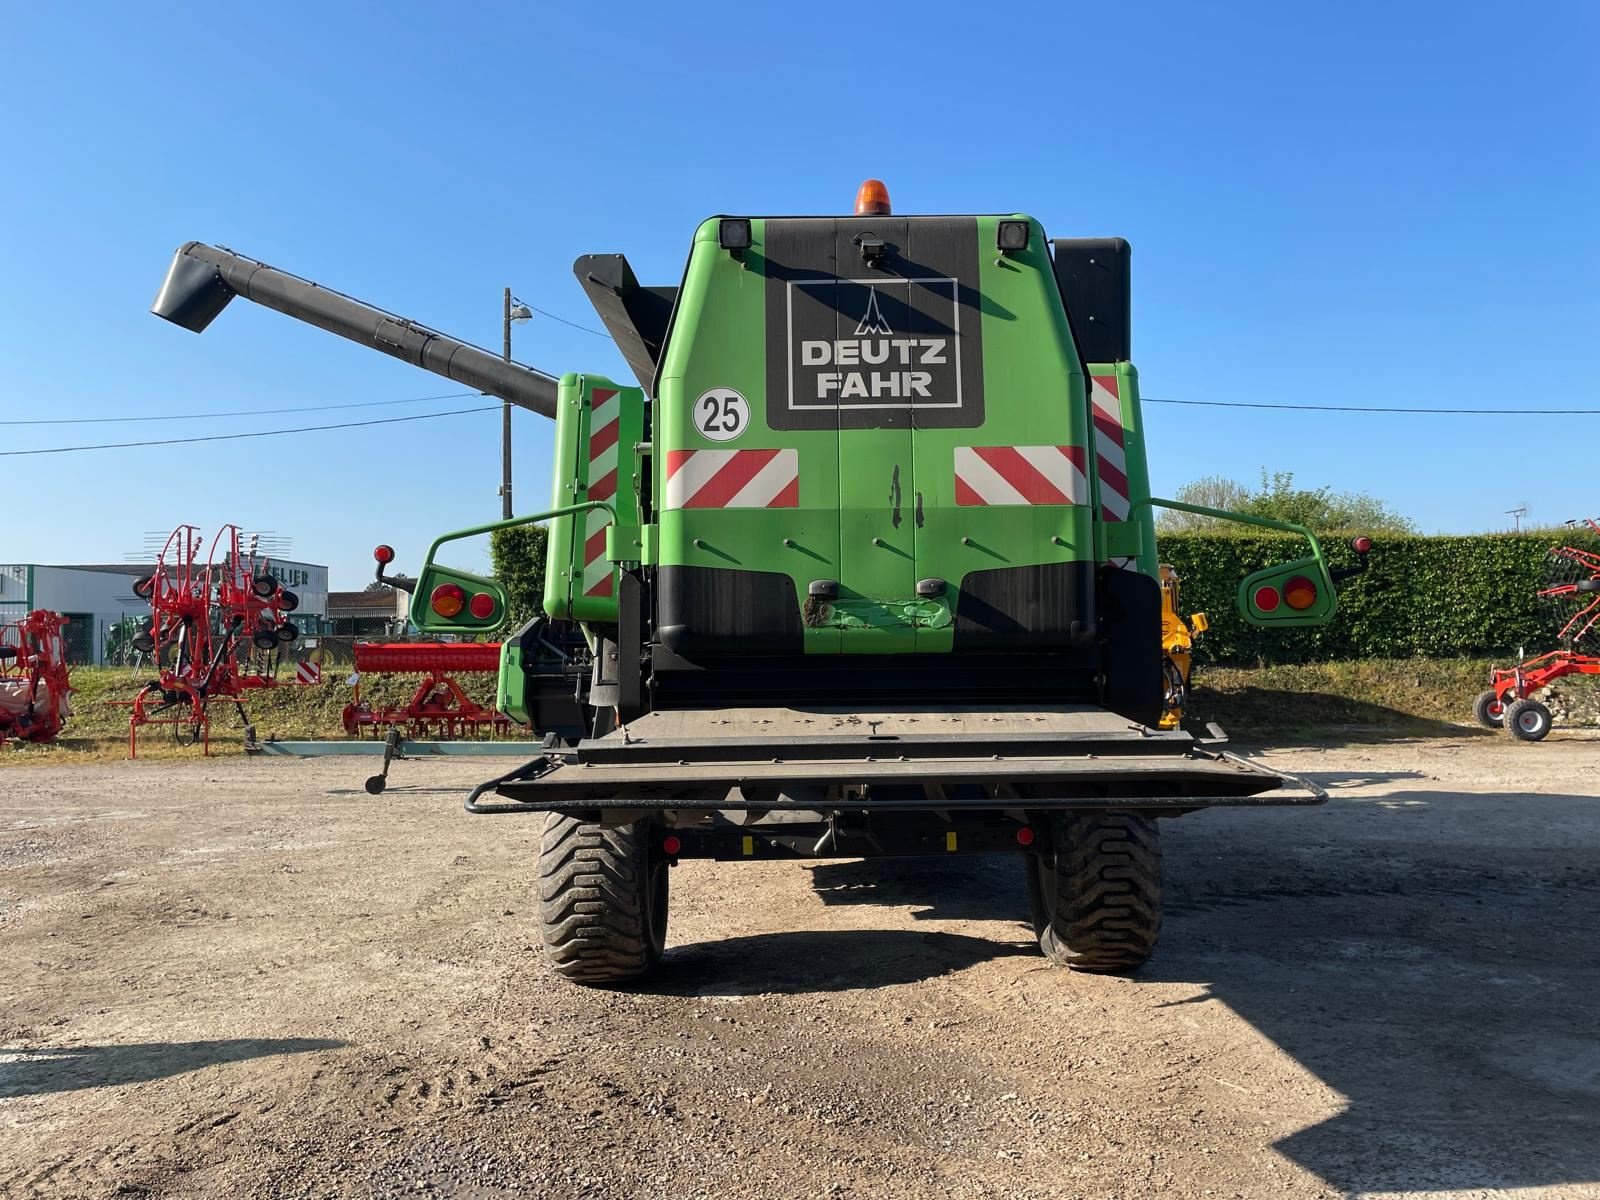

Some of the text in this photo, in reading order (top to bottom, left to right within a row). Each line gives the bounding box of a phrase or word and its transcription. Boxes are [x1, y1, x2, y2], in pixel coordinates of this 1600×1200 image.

[801, 339, 947, 366] DEUTZ
[817, 372, 932, 398] FAHR
[702, 397, 740, 432] 25
